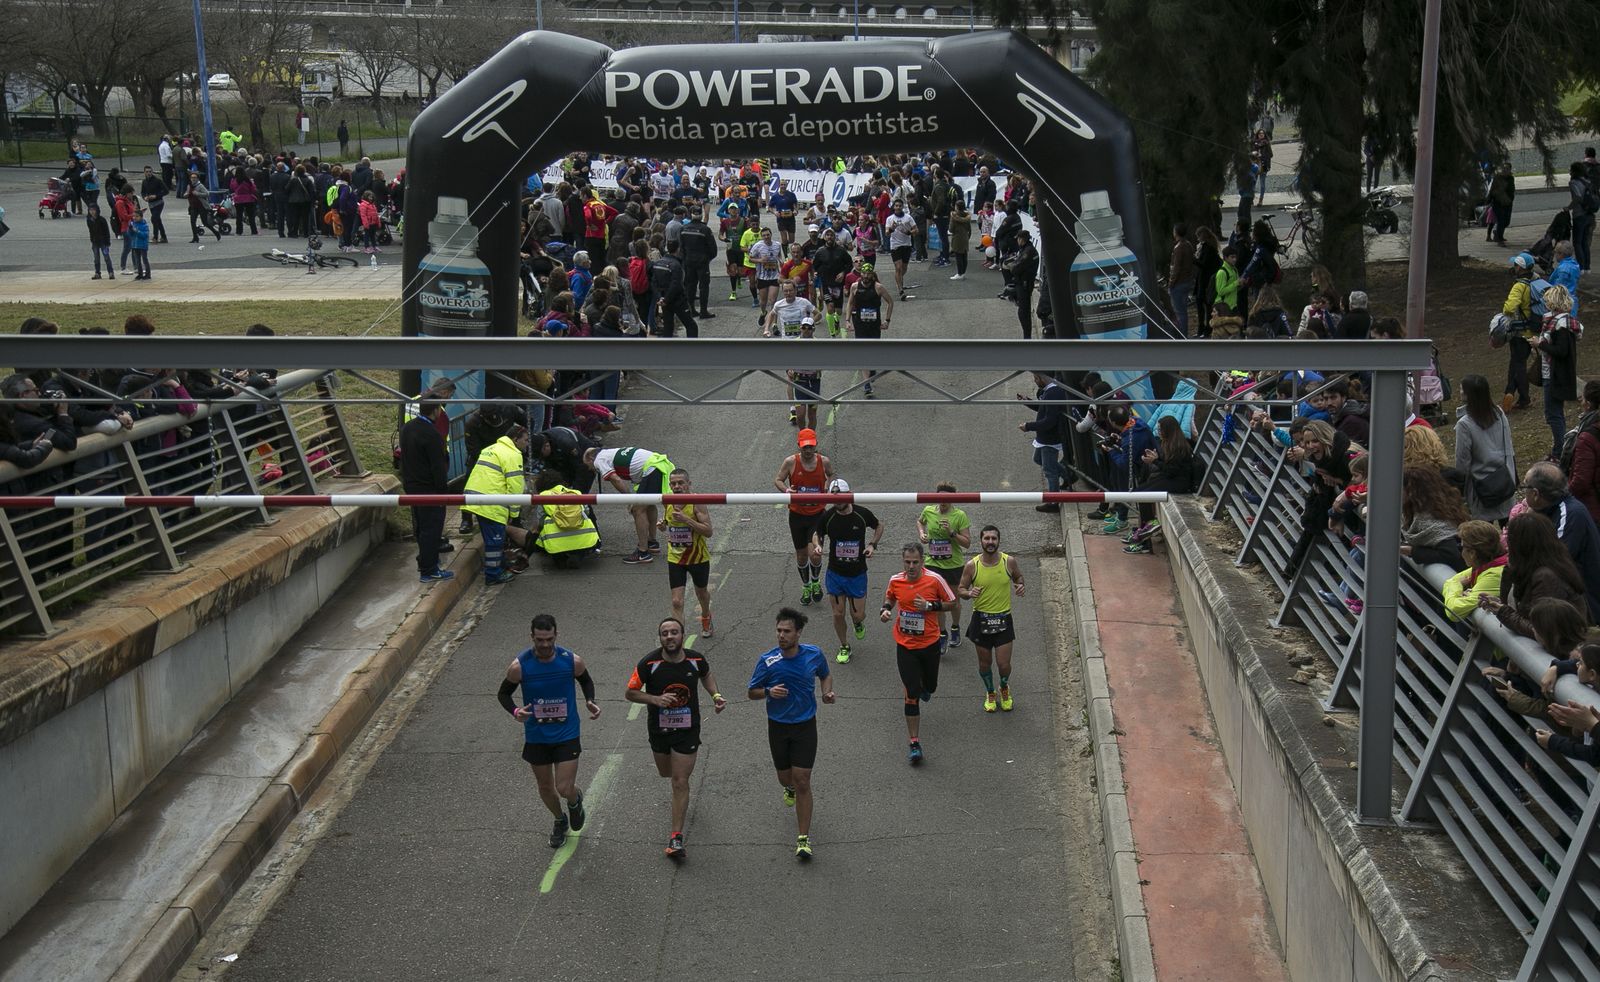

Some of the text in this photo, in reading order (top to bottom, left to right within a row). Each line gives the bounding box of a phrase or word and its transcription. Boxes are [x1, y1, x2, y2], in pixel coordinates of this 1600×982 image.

[605, 111, 939, 145] bebida para deportistas
[786, 179, 819, 193] ZURICH
[420, 293, 489, 308] POWERADE
[1077, 286, 1141, 304] POWERADE
